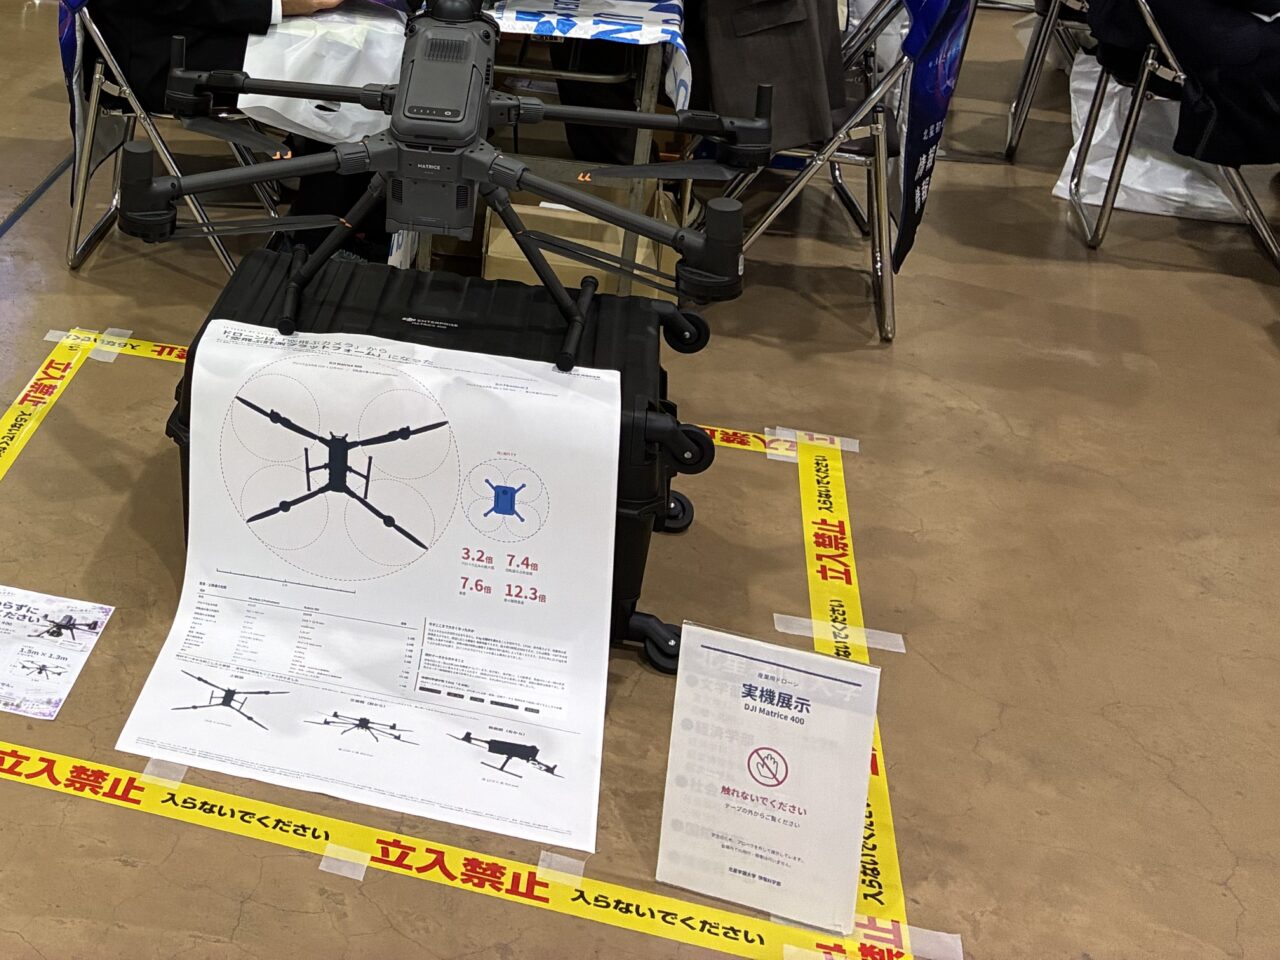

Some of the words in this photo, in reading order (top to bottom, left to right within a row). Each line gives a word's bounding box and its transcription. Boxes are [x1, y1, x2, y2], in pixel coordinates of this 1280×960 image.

[18, 358, 73, 408] 立入禁止
[814, 455, 834, 513] 入らないでください
[461, 547, 494, 565] 3.2倍
[506, 554, 538, 572] 7.4倍
[811, 518, 852, 586] 立入禁止
[460, 576, 492, 594] 7.6倍
[504, 583, 546, 603] 12.3倍
[740, 683, 811, 715] 実機展示
[743, 703, 758, 714] DJI
[758, 706, 789, 722] Matrice
[789, 715, 805, 725] 400
[160, 790, 331, 841] 入らないでください
[720, 785, 807, 817] 触れないでください
[724, 803, 801, 828] テープの外からご覧ください
[370, 838, 551, 904] 立入禁止
[570, 888, 766, 947] 入らないでください
